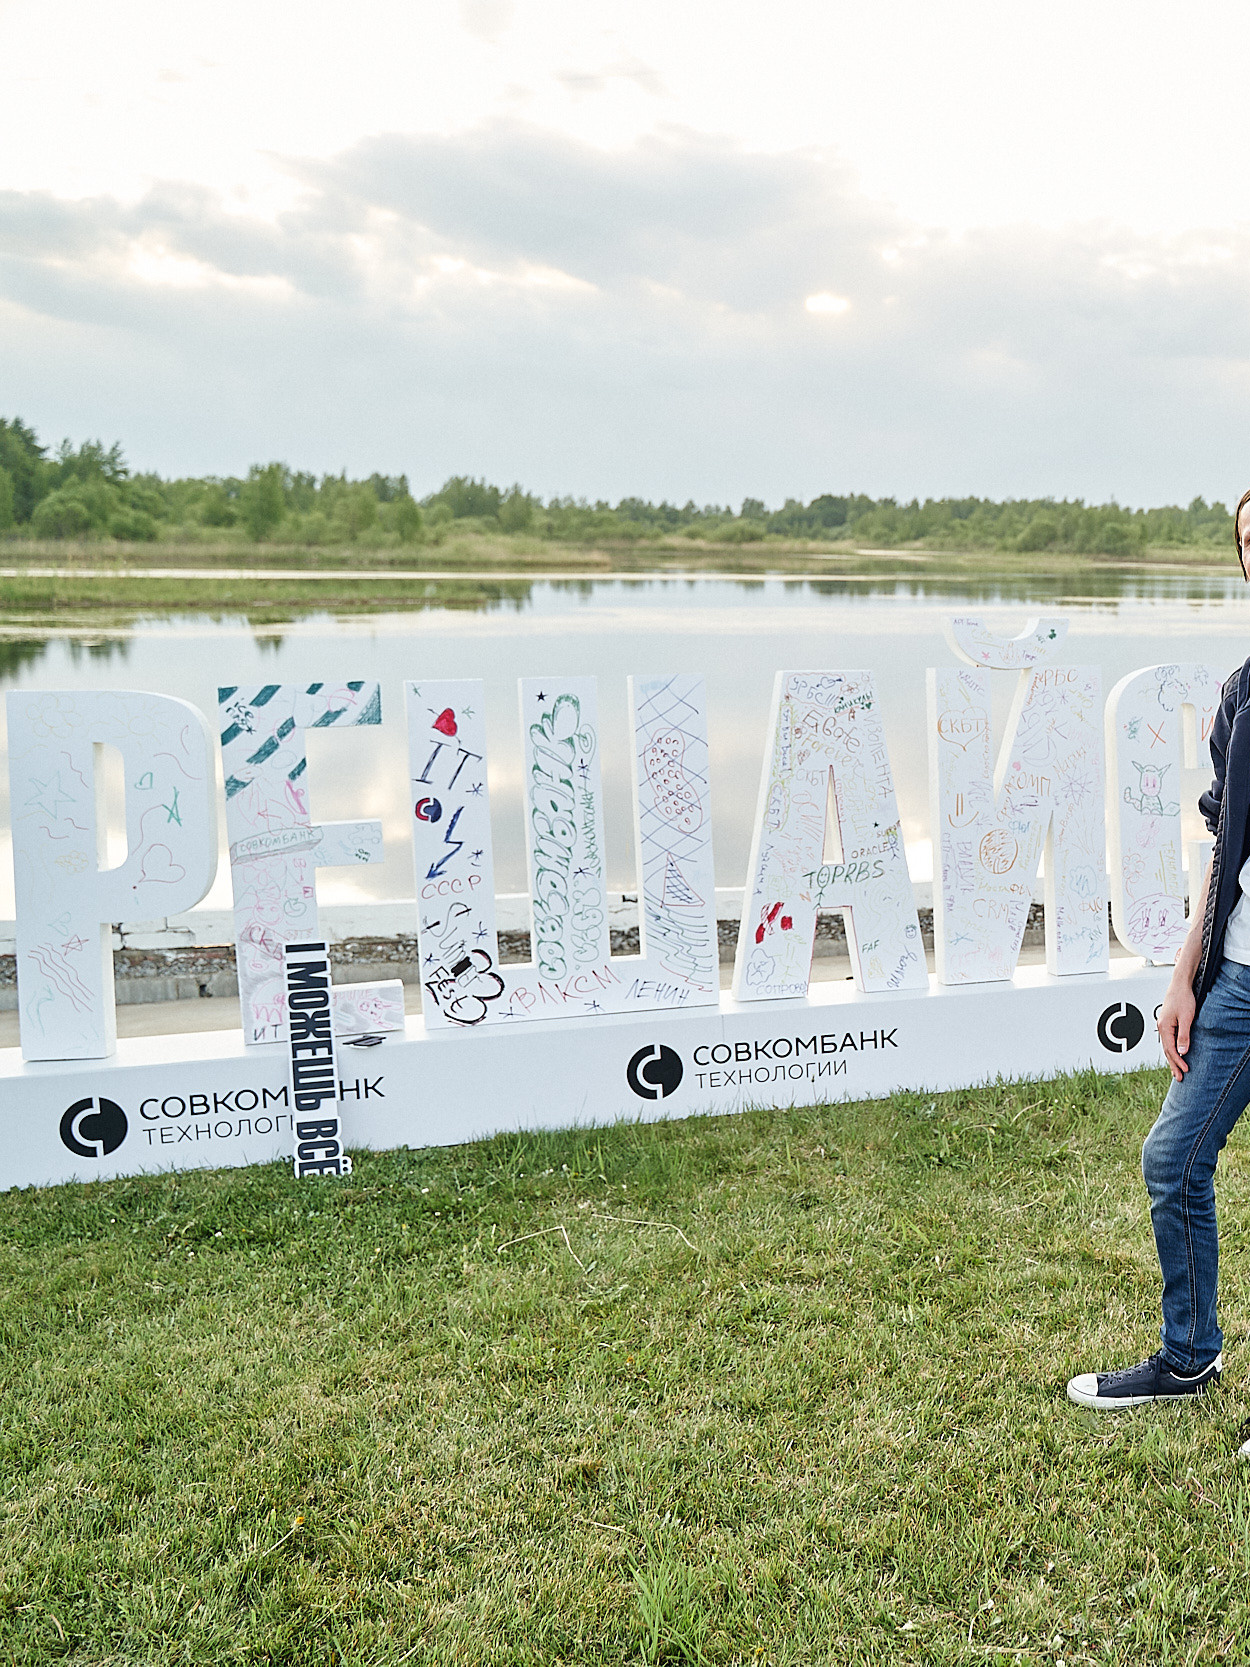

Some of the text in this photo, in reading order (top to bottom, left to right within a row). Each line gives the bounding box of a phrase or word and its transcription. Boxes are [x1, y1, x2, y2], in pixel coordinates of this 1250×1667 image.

[940, 718, 986, 735] СКБТ
[863, 711, 894, 798] ИЗОЛЕНТА
[239, 829, 317, 853] СОВКОМБАНК
[850, 842, 889, 860] ORACLE
[421, 874, 482, 900] СССР
[972, 898, 1010, 924] CRM
[510, 965, 622, 1013] ВЛКСМ
[625, 977, 690, 1002] ЛЕНИН
[286, 960, 337, 1112] МОЖЕШЬ
[693, 1028, 899, 1066] СОВКОМБАНК
[695, 1059, 847, 1089] ТЕХНОЛОГИИ
[139, 1076, 385, 1121] СОВКОМНК
[142, 1115, 294, 1146] ТЕХНОЛОГ
[297, 1118, 350, 1178] ВСЁ
